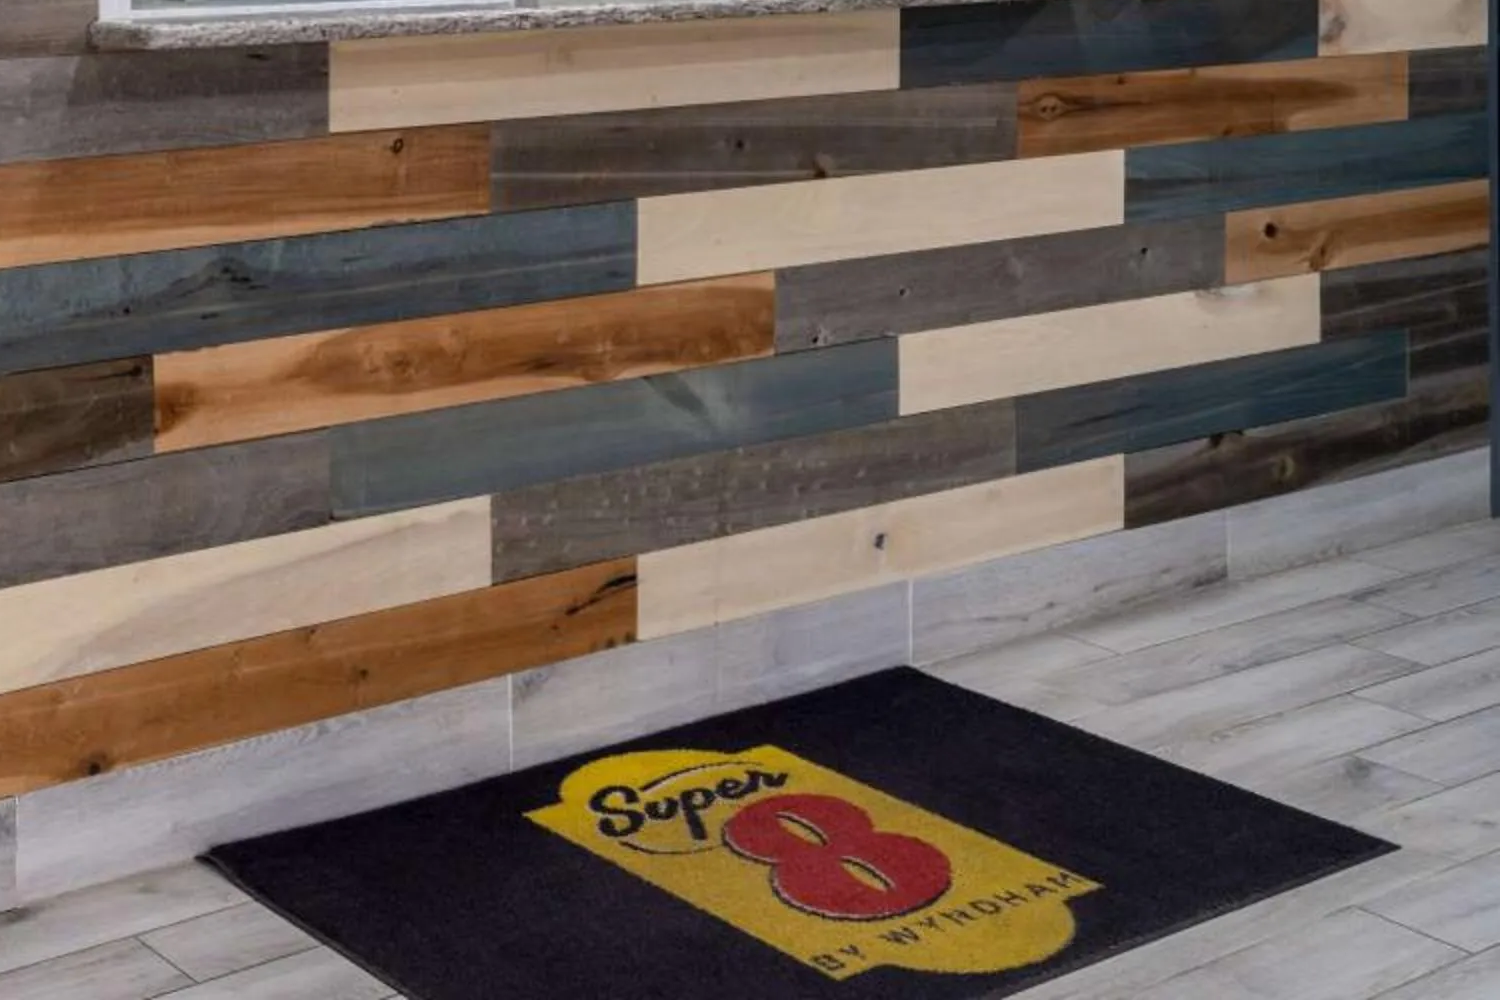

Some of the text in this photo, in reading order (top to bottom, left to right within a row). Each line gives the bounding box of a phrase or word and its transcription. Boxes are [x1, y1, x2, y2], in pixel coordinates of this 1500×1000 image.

[590, 766, 789, 842] Super
[722, 793, 954, 922] 8
[811, 871, 1084, 972] BY WYNDHAM
